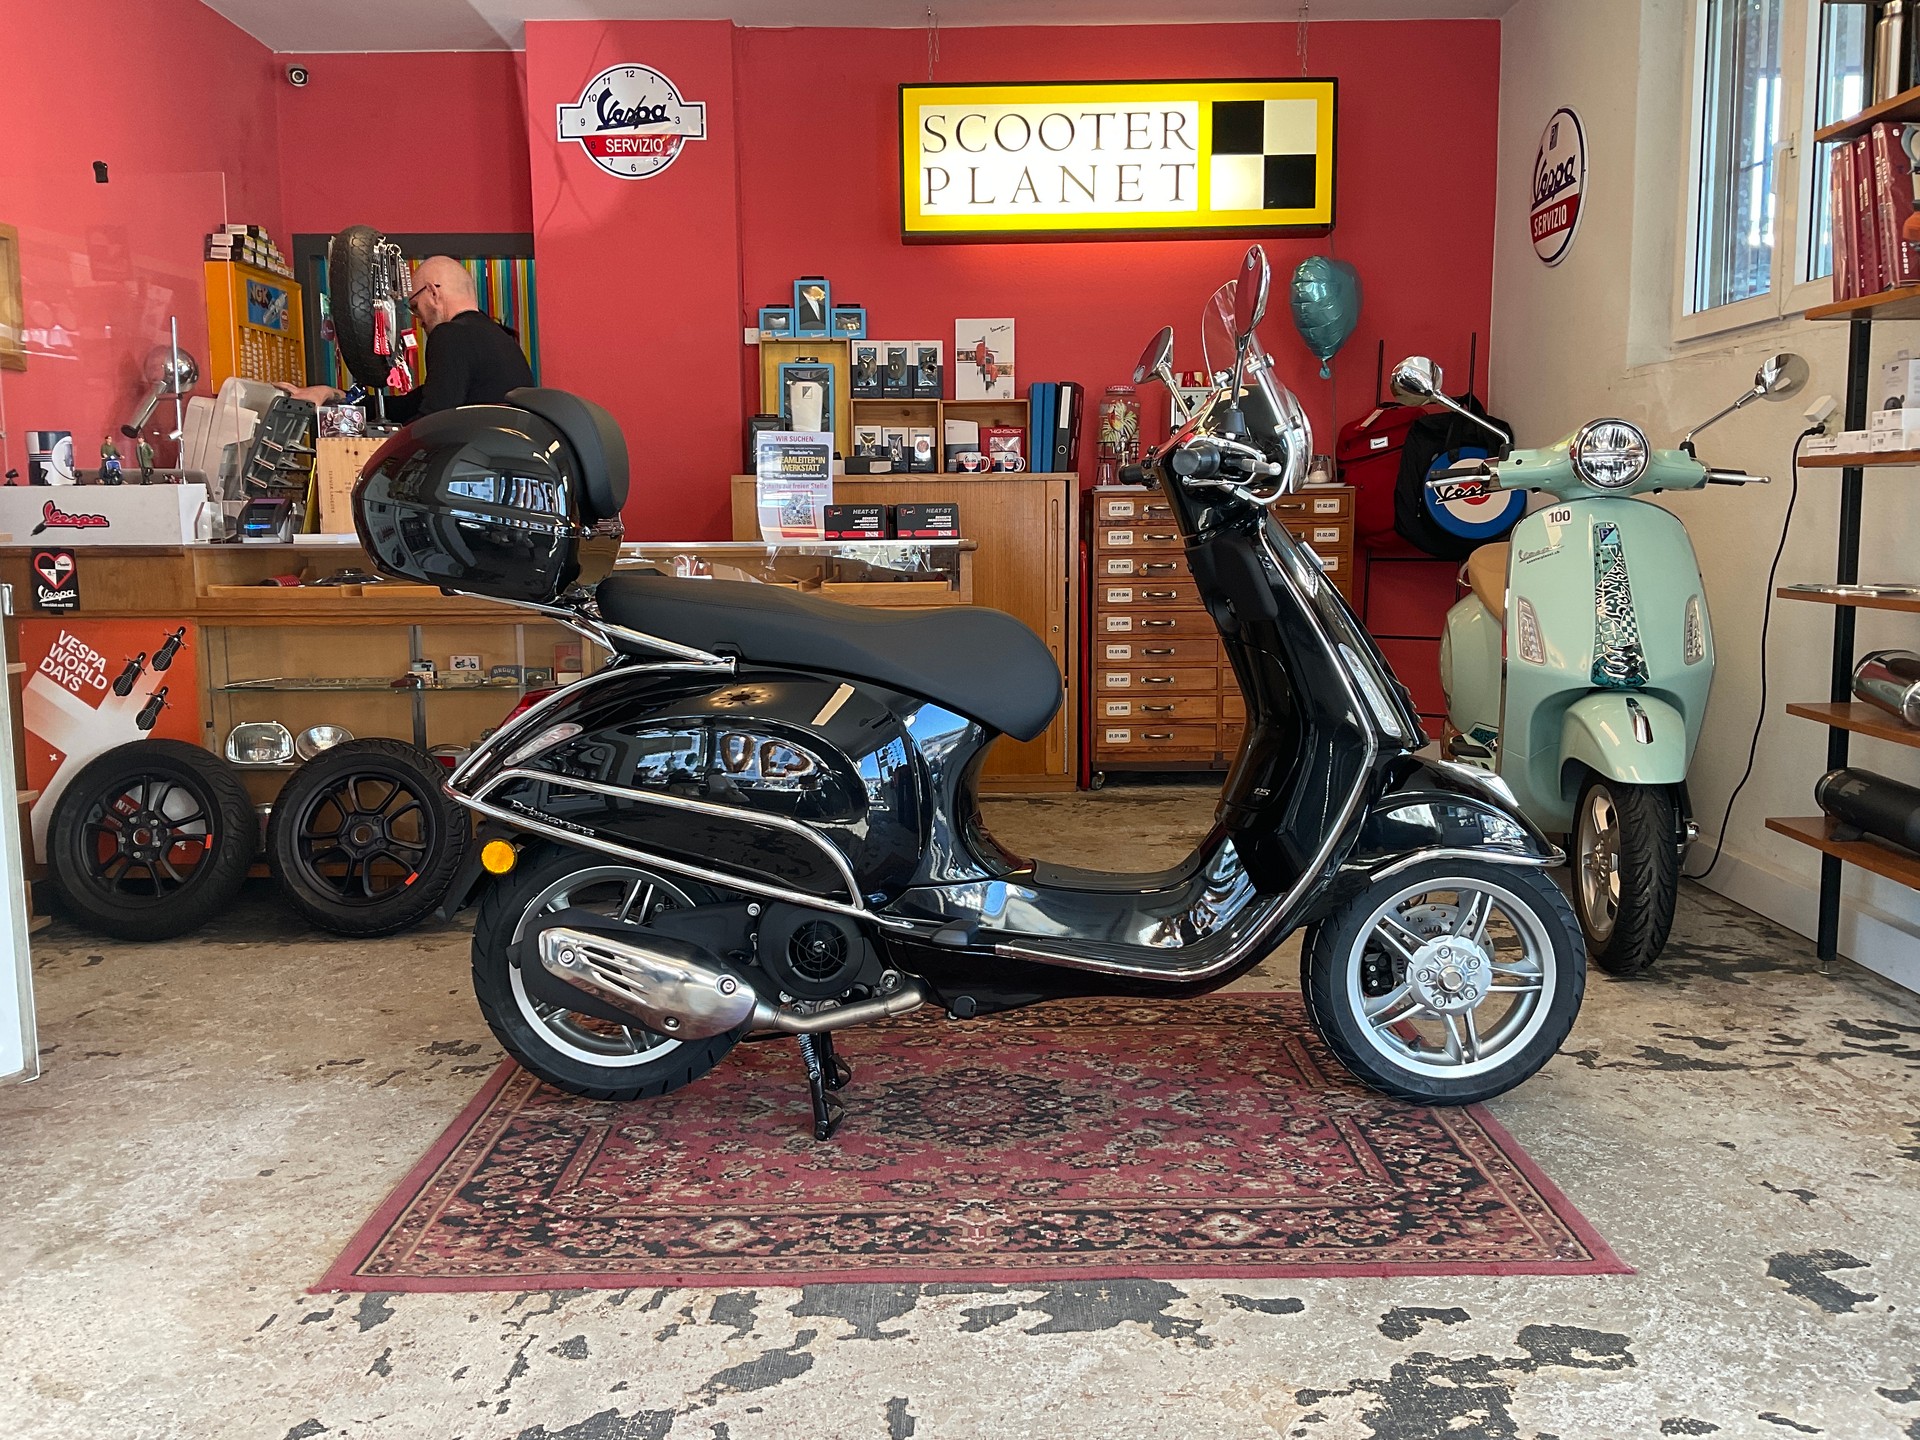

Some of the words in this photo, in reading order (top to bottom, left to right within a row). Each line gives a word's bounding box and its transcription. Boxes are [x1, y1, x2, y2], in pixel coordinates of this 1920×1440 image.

[602, 77, 611, 85] 11
[625, 70, 635, 78] 12
[588, 94, 597, 102] 10
[667, 93, 673, 101] 2
[596, 87, 671, 131] Vespa
[580, 118, 586, 126] 9
[922, 111, 1196, 153] SCOOTER
[1893, 129, 1900, 137] 6
[605, 138, 663, 153] SERVIZIO
[609, 158, 614, 166] 7
[631, 164, 637, 172] 6
[653, 158, 659, 166] 5
[923, 163, 1196, 206] PLANET
[1531, 145, 1577, 212] Vespa
[1534, 204, 1568, 237] SERVIZIO
[1901, 241, 1909, 275] COLORS
[249, 284, 270, 309] NGK
[781, 464, 821, 472] WERKSTATT
[43, 500, 110, 529] Vespa
[1548, 510, 1571, 523] 100
[1600, 529, 1610, 539] P
[37, 584, 78, 603] Vespa
[58, 630, 107, 673] VESPA
[39, 657, 82, 692] DAYS
[49, 643, 108, 691] WORLD
[510, 799, 595, 837] Primavera
